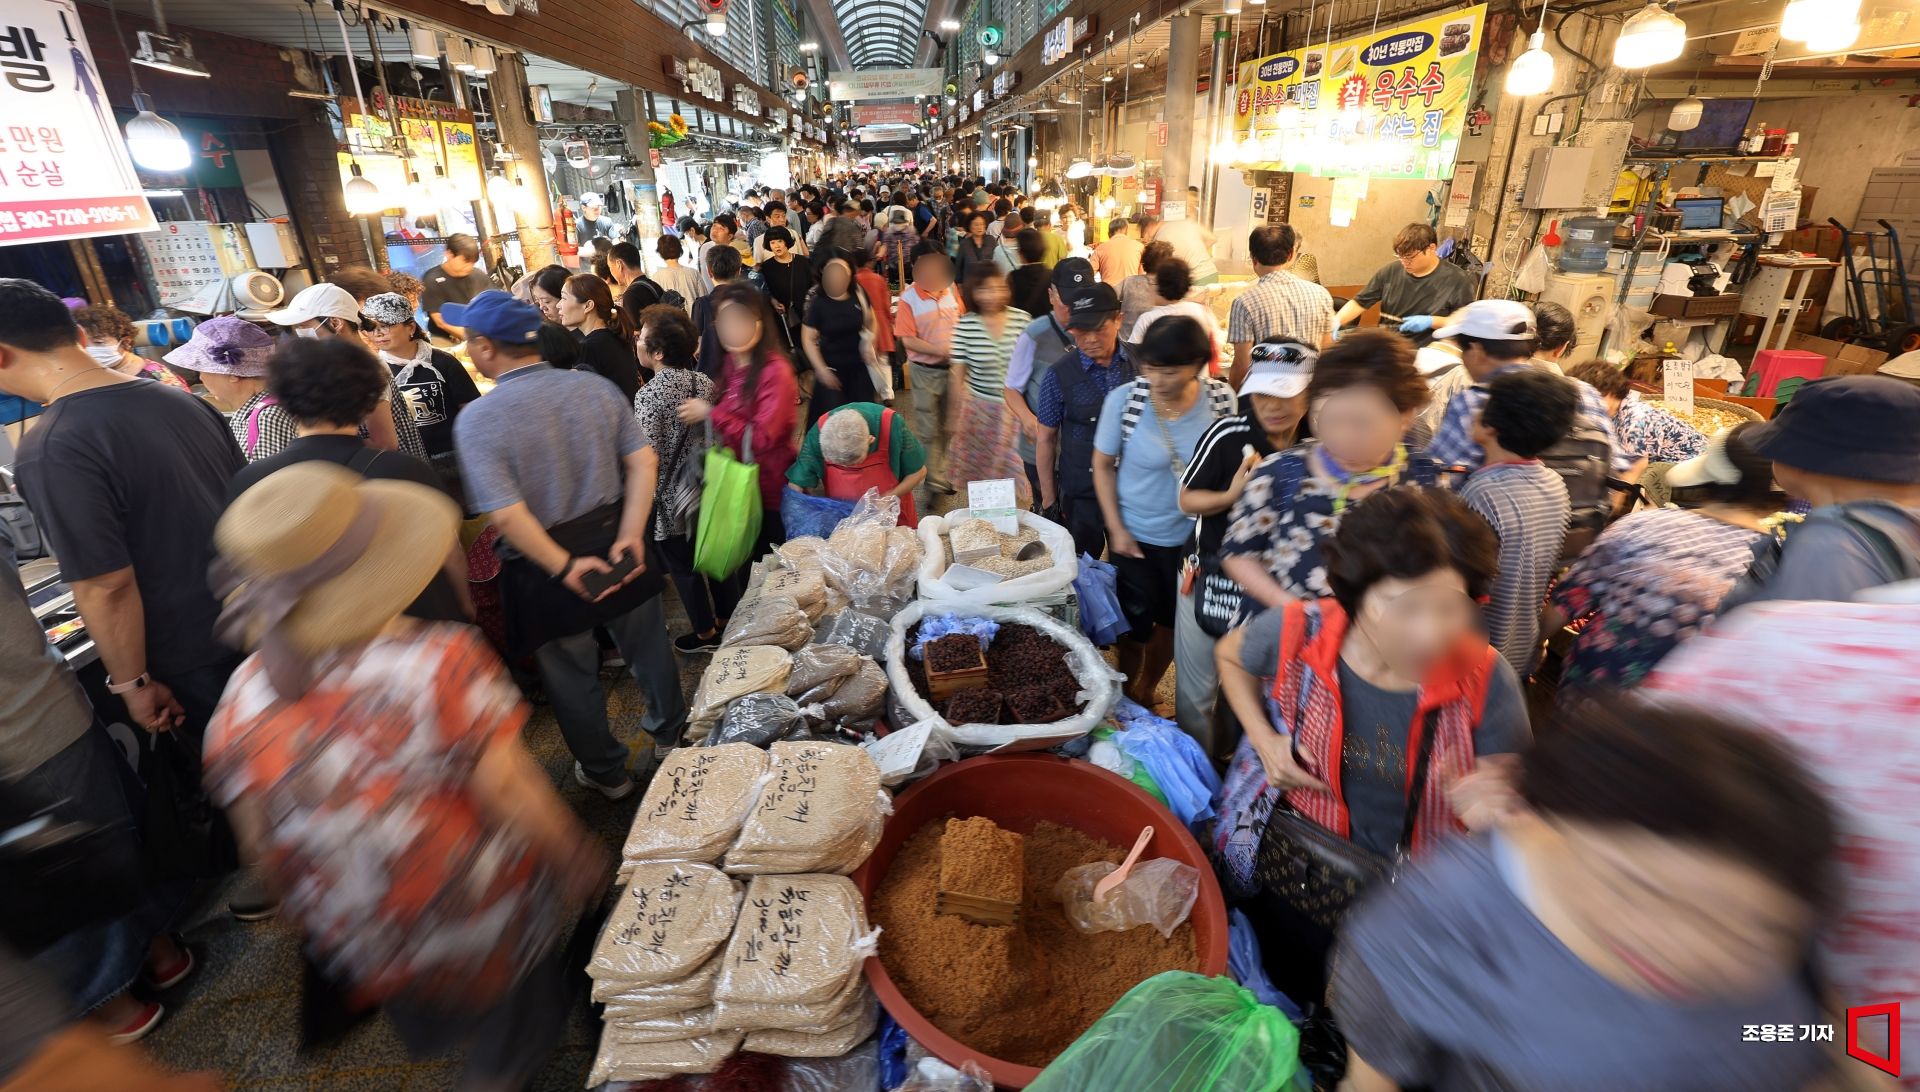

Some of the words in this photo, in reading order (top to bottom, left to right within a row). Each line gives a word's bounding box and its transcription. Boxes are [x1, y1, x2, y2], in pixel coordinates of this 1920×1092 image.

[1368, 43, 1388, 62] 30년
[1389, 35, 1425, 59] 전통맛집
[1259, 66, 1273, 79] 30년
[1273, 60, 1294, 76] 전통맛집
[1240, 92, 1248, 113] 찰
[1252, 84, 1285, 114] 옥수수
[1287, 79, 1321, 110] 매집
[1372, 63, 1444, 110] 옥수수
[0, 126, 65, 154] 만원
[1421, 110, 1444, 148] 집
[16, 160, 65, 188] 순살
[16, 205, 140, 230] 302-7210-9196-11
[169, 225, 178, 234] 9
[1204, 586, 1242, 607] Bunny
[679, 753, 718, 822] 볶음참깨
[783, 749, 828, 823] 볶음참깨
[640, 872, 694, 955] 볶음참깨
[769, 886, 812, 977] 볶음참깨
